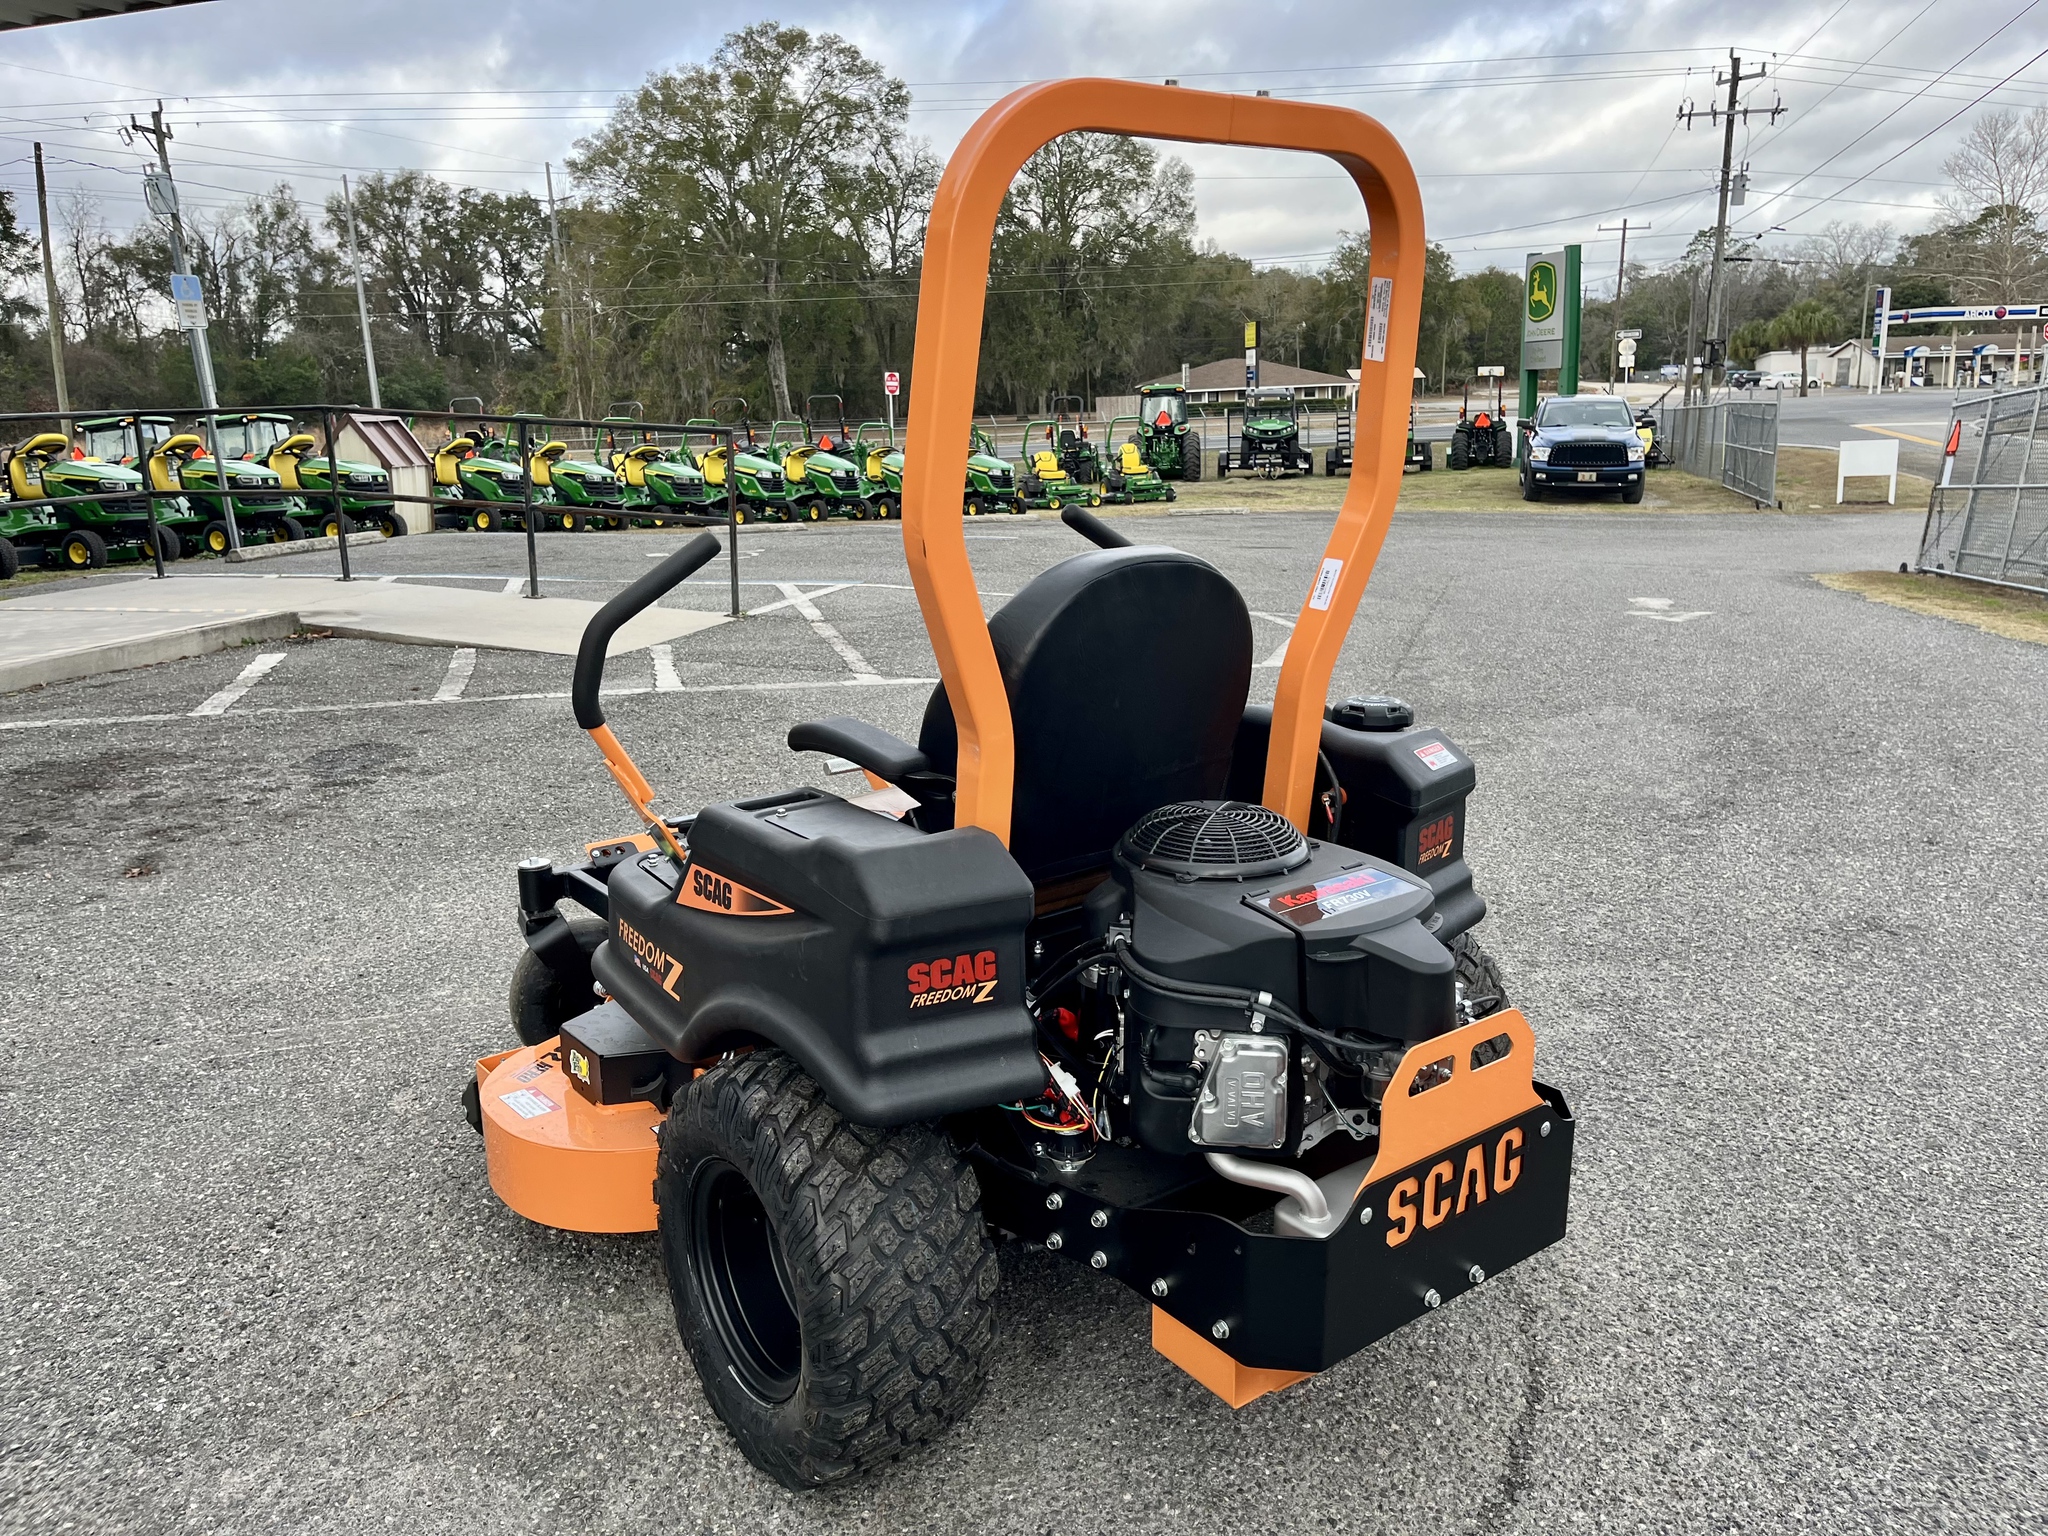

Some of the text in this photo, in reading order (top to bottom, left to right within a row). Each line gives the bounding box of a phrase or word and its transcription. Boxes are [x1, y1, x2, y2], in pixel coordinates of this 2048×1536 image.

[1963, 310, 1990, 318] ARCO
[1419, 815, 1454, 853] SCAG
[693, 869, 732, 910] SCAG
[1277, 873, 1377, 907] Kawasaki
[1322, 890, 1372, 910] FR730V
[907, 950, 997, 993] SCAG
[1241, 1071, 1266, 1128] OHV
[1386, 1126, 1524, 1248] SCAG
